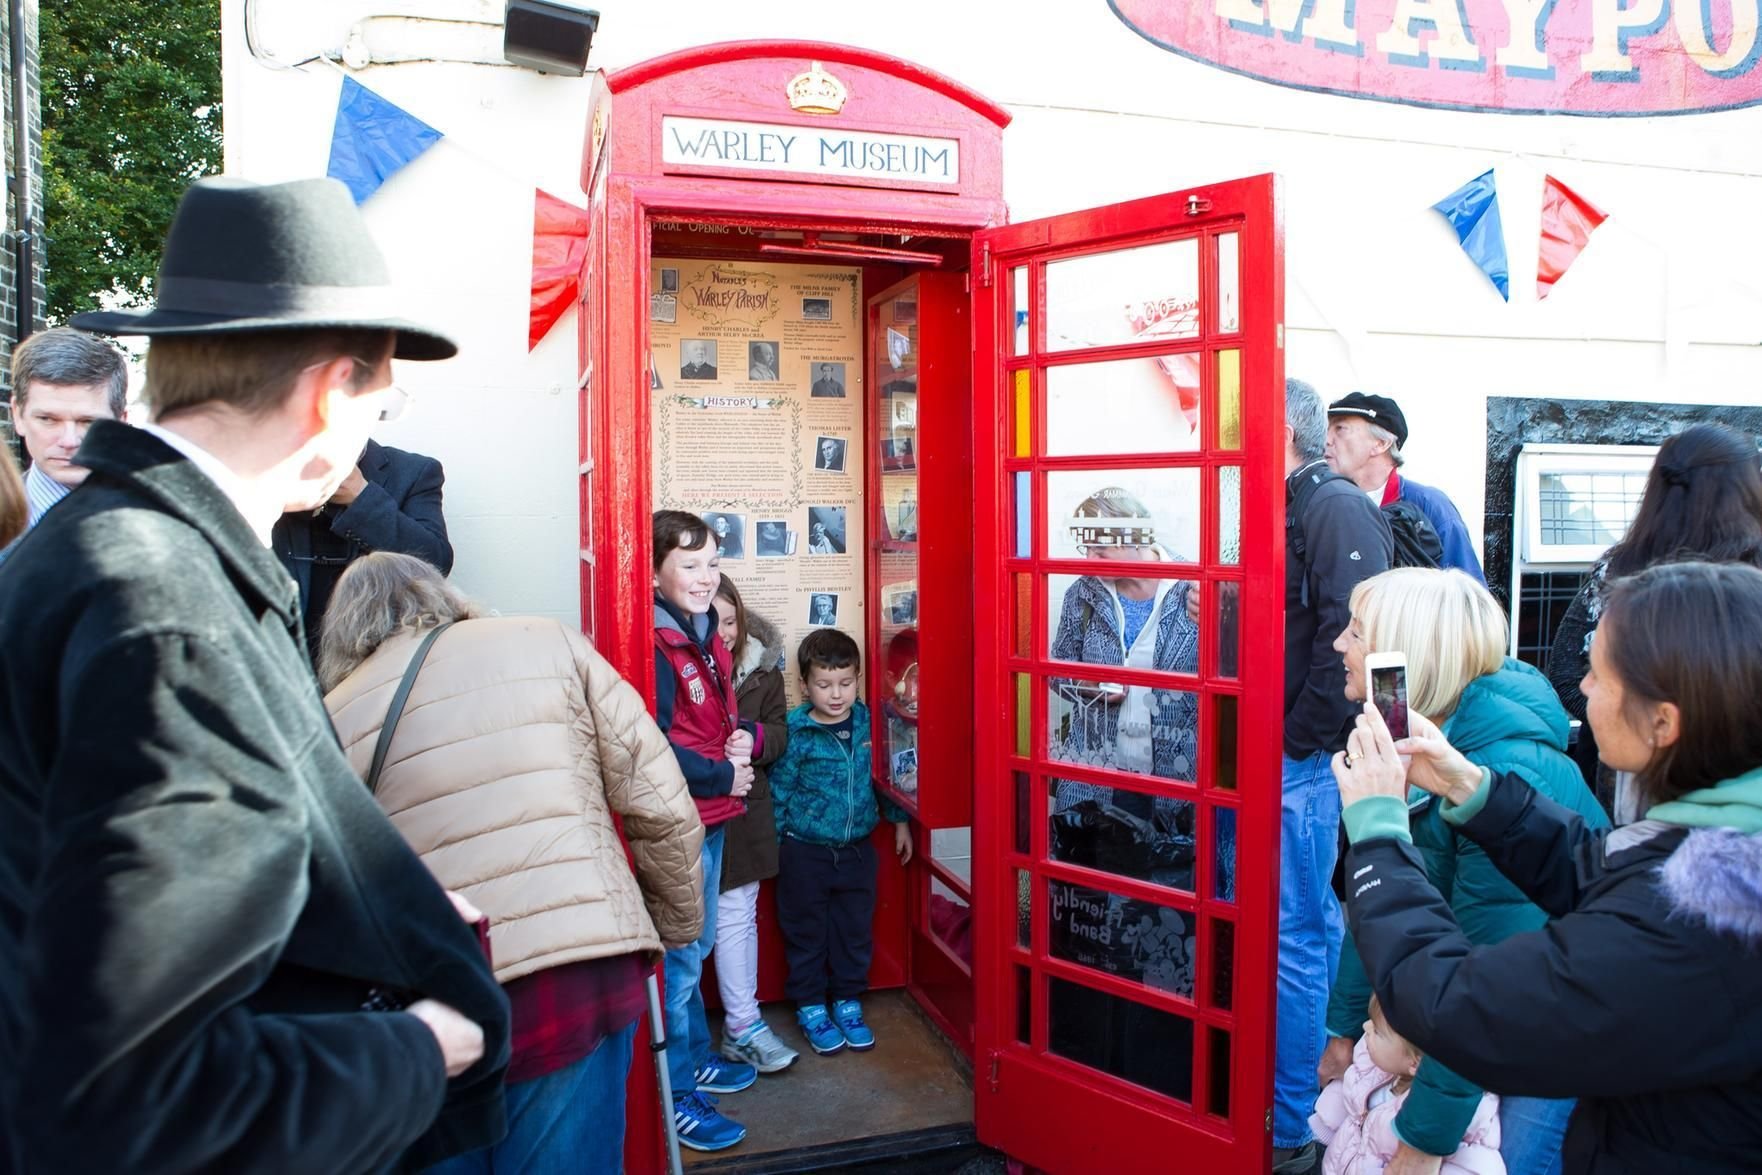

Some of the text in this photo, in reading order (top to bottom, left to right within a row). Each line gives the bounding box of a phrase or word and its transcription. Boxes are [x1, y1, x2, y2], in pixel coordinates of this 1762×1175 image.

[672, 127, 950, 177] WARLEY MUSEUM
[688, 224, 730, 235] OPENING
[691, 286, 771, 314] WARLEY PARISH
[707, 397, 754, 407] HISTORY
